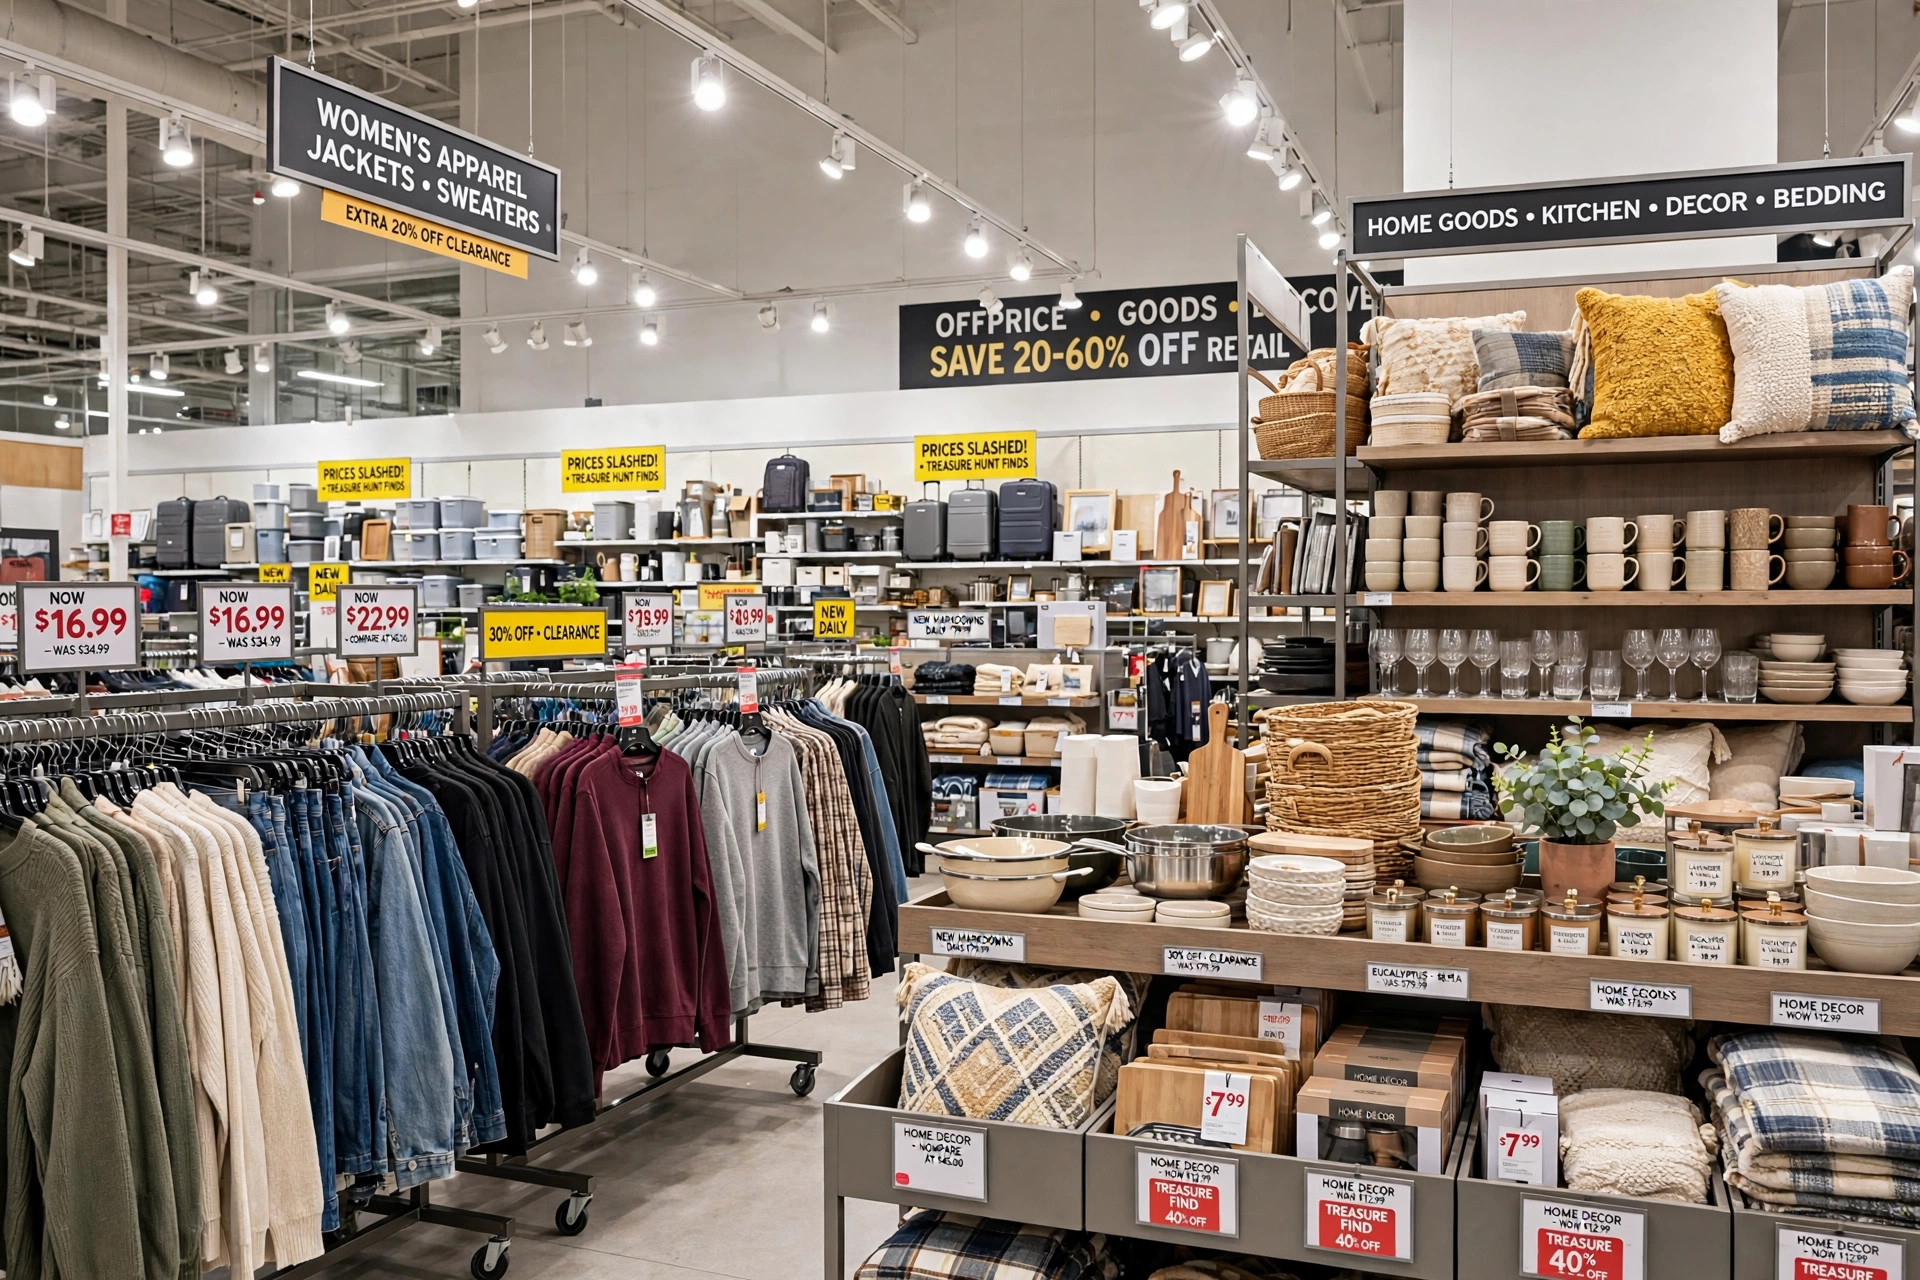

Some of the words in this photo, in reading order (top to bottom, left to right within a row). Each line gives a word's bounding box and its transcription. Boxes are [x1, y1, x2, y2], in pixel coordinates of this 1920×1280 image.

[317, 97, 431, 163] WOMEN'S
[437, 146, 527, 199] APPAREL
[307, 135, 415, 192] JACKETS
[437, 178, 539, 234] SWEATERS
[1368, 214, 1433, 236] HOME
[1438, 207, 1518, 233] GOODS
[1542, 199, 1640, 225] KITCHEN
[1666, 191, 1748, 217] DECOR
[1774, 181, 1886, 209] BEDDING
[346, 204, 388, 231] EXTRA
[392, 219, 417, 240] 20%
[421, 228, 443, 246] OFF
[446, 236, 511, 268] CLEARANCE
[1117, 295, 1217, 326] GOODS
[930, 342, 1004, 378] SAVE
[1013, 335, 1129, 374] 20-60%
[1138, 331, 1198, 367] OFF
[922, 442, 964, 457] PRICES
[967, 439, 1027, 455] SLASHED!
[568, 456, 603, 470] PRICES
[607, 454, 657, 468] SLASHED!
[927, 459, 972, 472] TREASURE
[975, 458, 999, 470] HUNT
[1002, 457, 1028, 469] FINDS
[324, 467, 355, 480] PRICES
[358, 465, 404, 479] SLASHED!
[571, 472, 610, 483] TREASURE
[612, 471, 634, 482] HUNT
[636, 470, 658, 481] FINDS
[327, 483, 361, 493] TREASURE
[363, 481, 382, 491] HUNT
[384, 481, 405, 491] FINDS
[264, 568, 284, 577] NEW
[315, 568, 340, 579] NEW
[50, 591, 85, 605] NOW
[220, 591, 248, 603] NOW
[355, 592, 378, 603] NOW
[209, 605, 285, 633] $16.99
[347, 606, 409, 631] $22.99
[822, 605, 845, 618] NEW
[35, 607, 127, 639] $16.99
[820, 620, 847, 634] DAILY
[489, 626, 512, 642] 30%
[514, 625, 534, 641] OFF
[543, 625, 600, 640] CLEARANCE
[53, 645, 76, 655] WAS
[78, 643, 110, 655] $34.99
[226, 637, 248, 648] WAS
[1597, 985, 1628, 996] HOME
[1779, 998, 1817, 1011] HOME
[1821, 1002, 1864, 1015] DECOR
[1380, 1076, 1408, 1087] DECOR
[1338, 1107, 1363, 1119] HOME
[1366, 1110, 1395, 1121] DECOR
[904, 1127, 934, 1140] HOME
[936, 1132, 971, 1146] DECOR
[924, 1154, 935, 1164] AT
[1184, 1161, 1219, 1175] DECOR
[1155, 1182, 1213, 1199] TREASURE
[1322, 1178, 1354, 1191] HOME
[1359, 1183, 1394, 1197] DECOR
[1169, 1196, 1199, 1210] FIND
[1325, 1204, 1388, 1223] TREASURE
[1544, 1205, 1578, 1219] HOME
[1582, 1210, 1622, 1226] DECOR
[1189, 1216, 1207, 1227] OFF
[1340, 1219, 1372, 1234] FIND
[1361, 1240, 1380, 1252] OFF
[1546, 1232, 1612, 1253] TREASURE
[1797, 1235, 1834, 1249] HOME
[1837, 1241, 1879, 1256] DECOR
[1549, 1249, 1596, 1274] 40%
[1586, 1269, 1608, 1280] OFF
[1801, 1262, 1874, 1280] TREASURE
